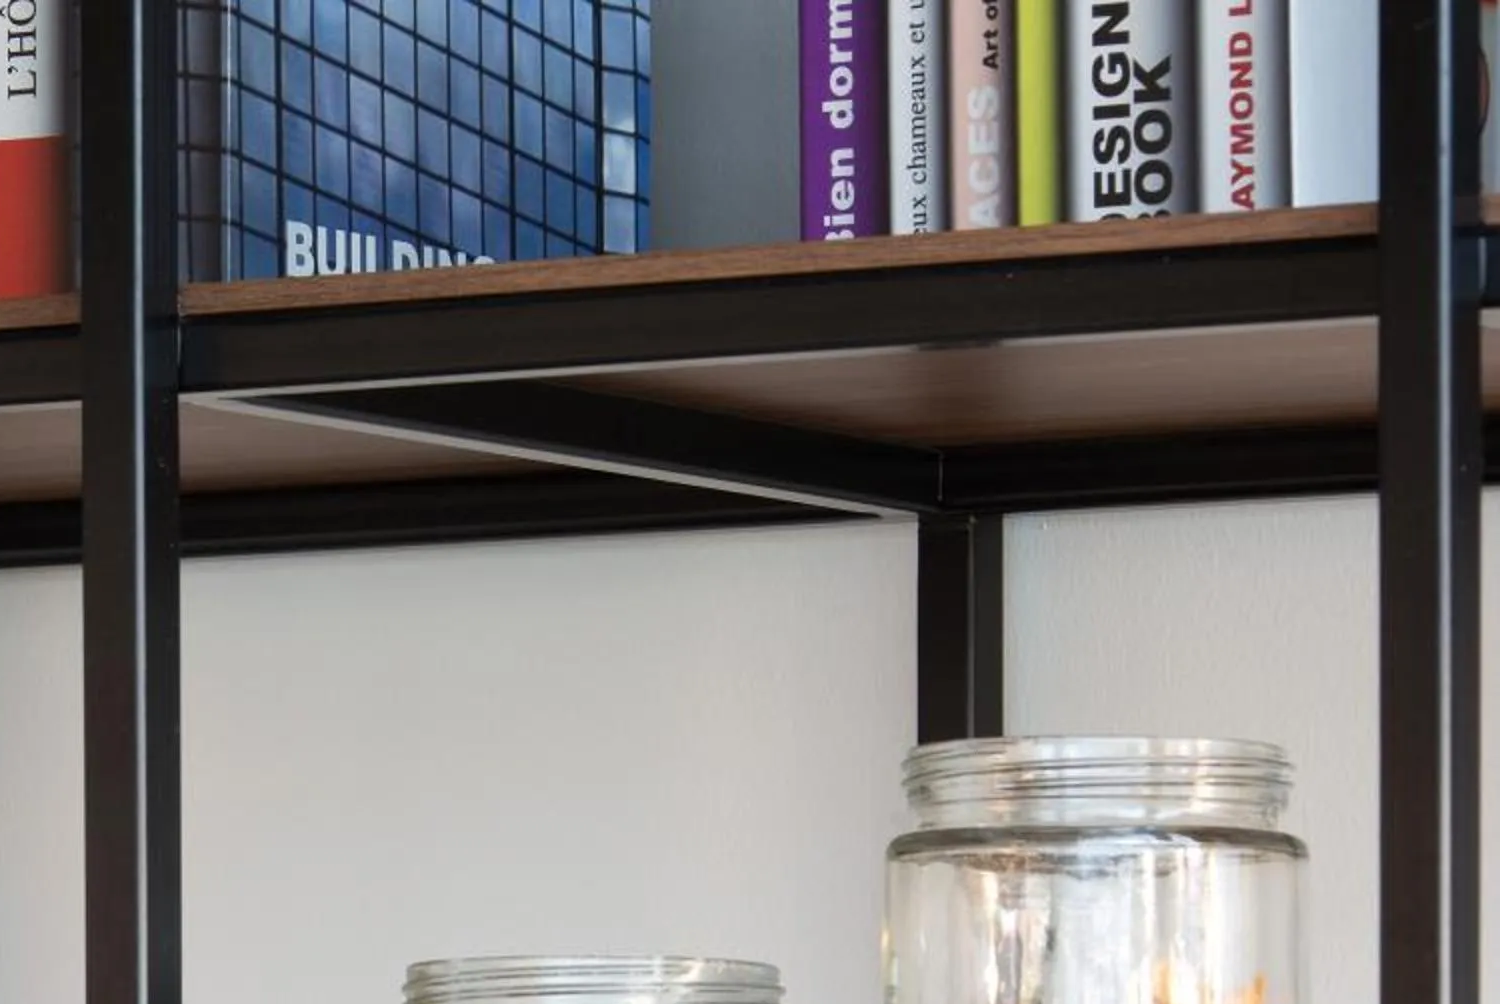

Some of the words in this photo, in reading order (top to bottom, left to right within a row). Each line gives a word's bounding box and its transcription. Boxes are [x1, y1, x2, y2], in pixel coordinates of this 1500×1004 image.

[822, 0, 854, 129] dorm
[910, 21, 925, 43] et
[982, 29, 999, 70] Art
[906, 54, 927, 184] chameaux
[1092, 2, 1131, 220] ESIGN
[1133, 54, 1173, 219] OOK
[1229, 32, 1255, 211] AYMOND
